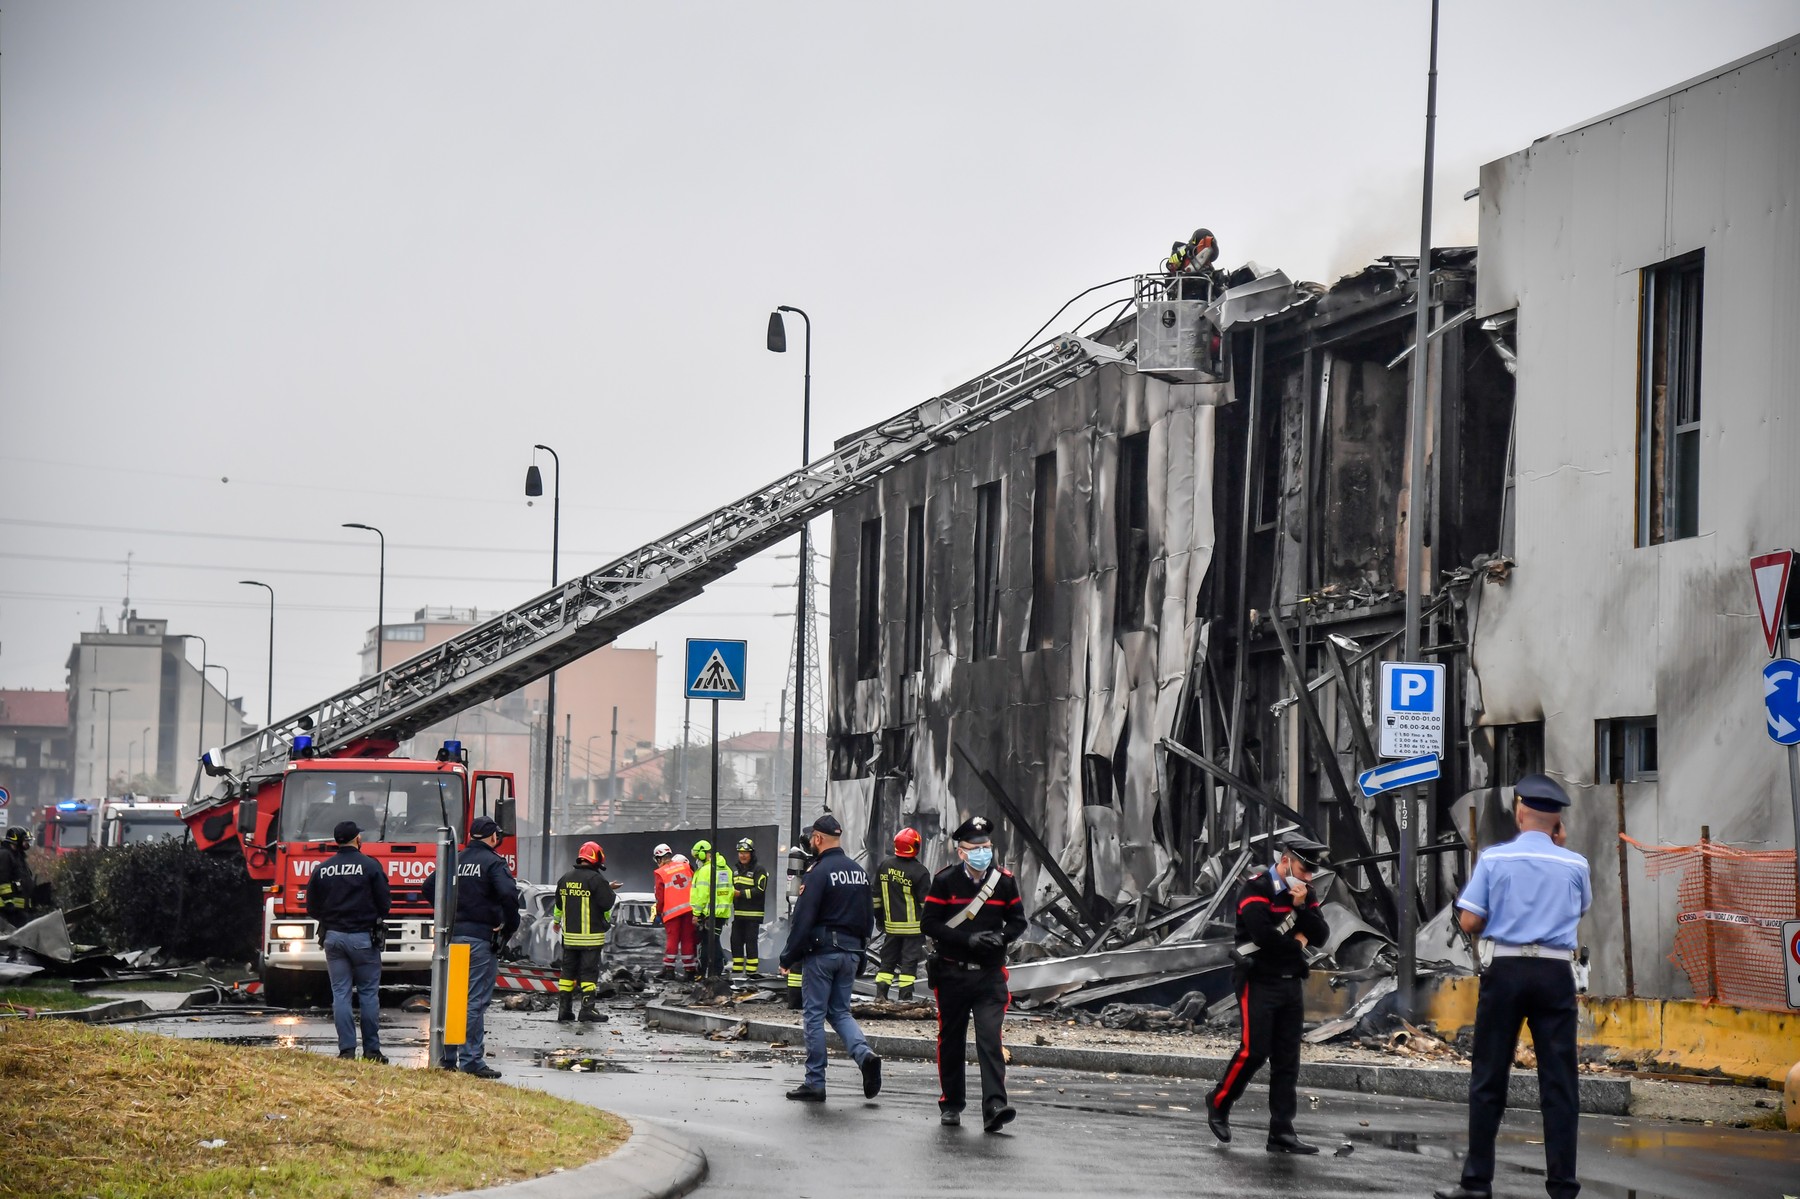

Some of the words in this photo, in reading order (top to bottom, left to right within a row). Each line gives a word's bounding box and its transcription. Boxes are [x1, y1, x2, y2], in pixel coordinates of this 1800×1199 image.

[1401, 673, 1427, 706] P
[320, 864, 363, 879] POLIZIA
[888, 868, 905, 878] VIGILI
[830, 870, 869, 886] POLIZIA
[569, 889, 591, 897] FUOCO
[1680, 913, 1697, 922] CORSO
